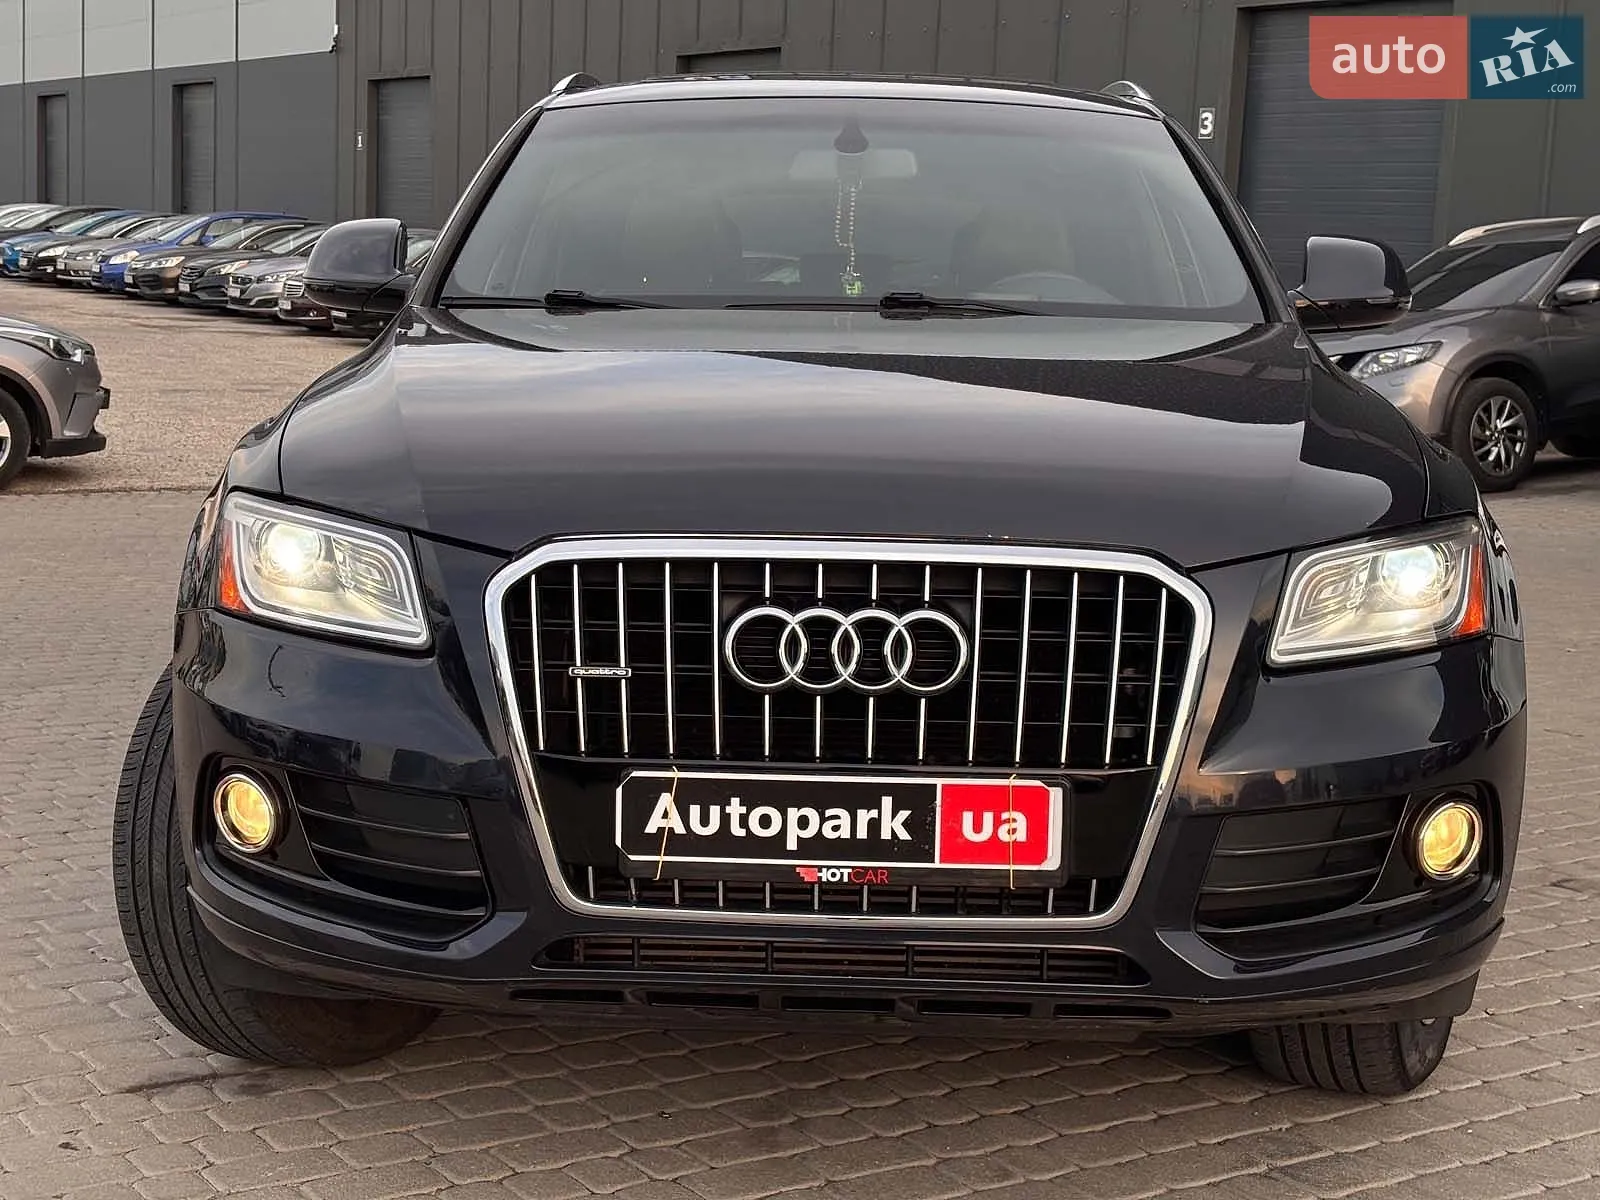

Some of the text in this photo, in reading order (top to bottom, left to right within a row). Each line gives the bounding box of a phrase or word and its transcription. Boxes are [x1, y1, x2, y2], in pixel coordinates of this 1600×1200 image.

[1200, 112, 1213, 135] 3
[573, 667, 627, 676] quattro
[643, 792, 1028, 851] Autopark ua
